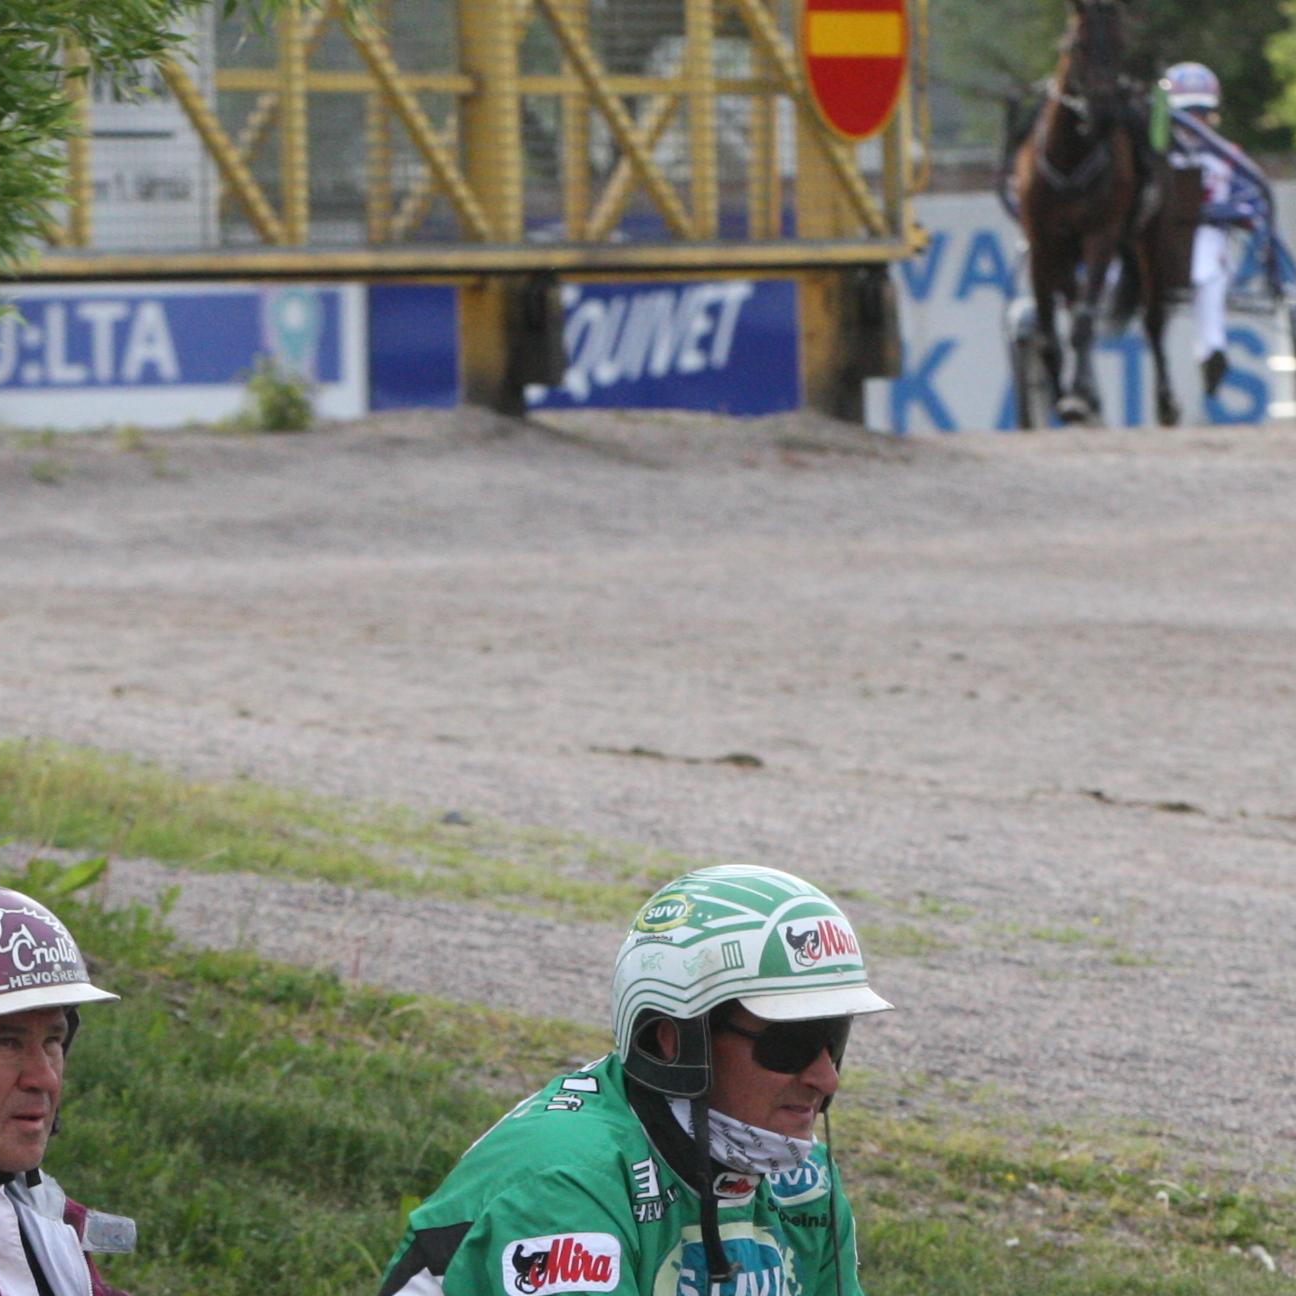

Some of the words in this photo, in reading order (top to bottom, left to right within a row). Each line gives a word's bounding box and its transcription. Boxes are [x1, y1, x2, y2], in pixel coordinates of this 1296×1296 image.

[644, 903, 685, 921] SUVI
[12, 936, 78, 973] Criollo
[530, 1238, 613, 1287] Mira
